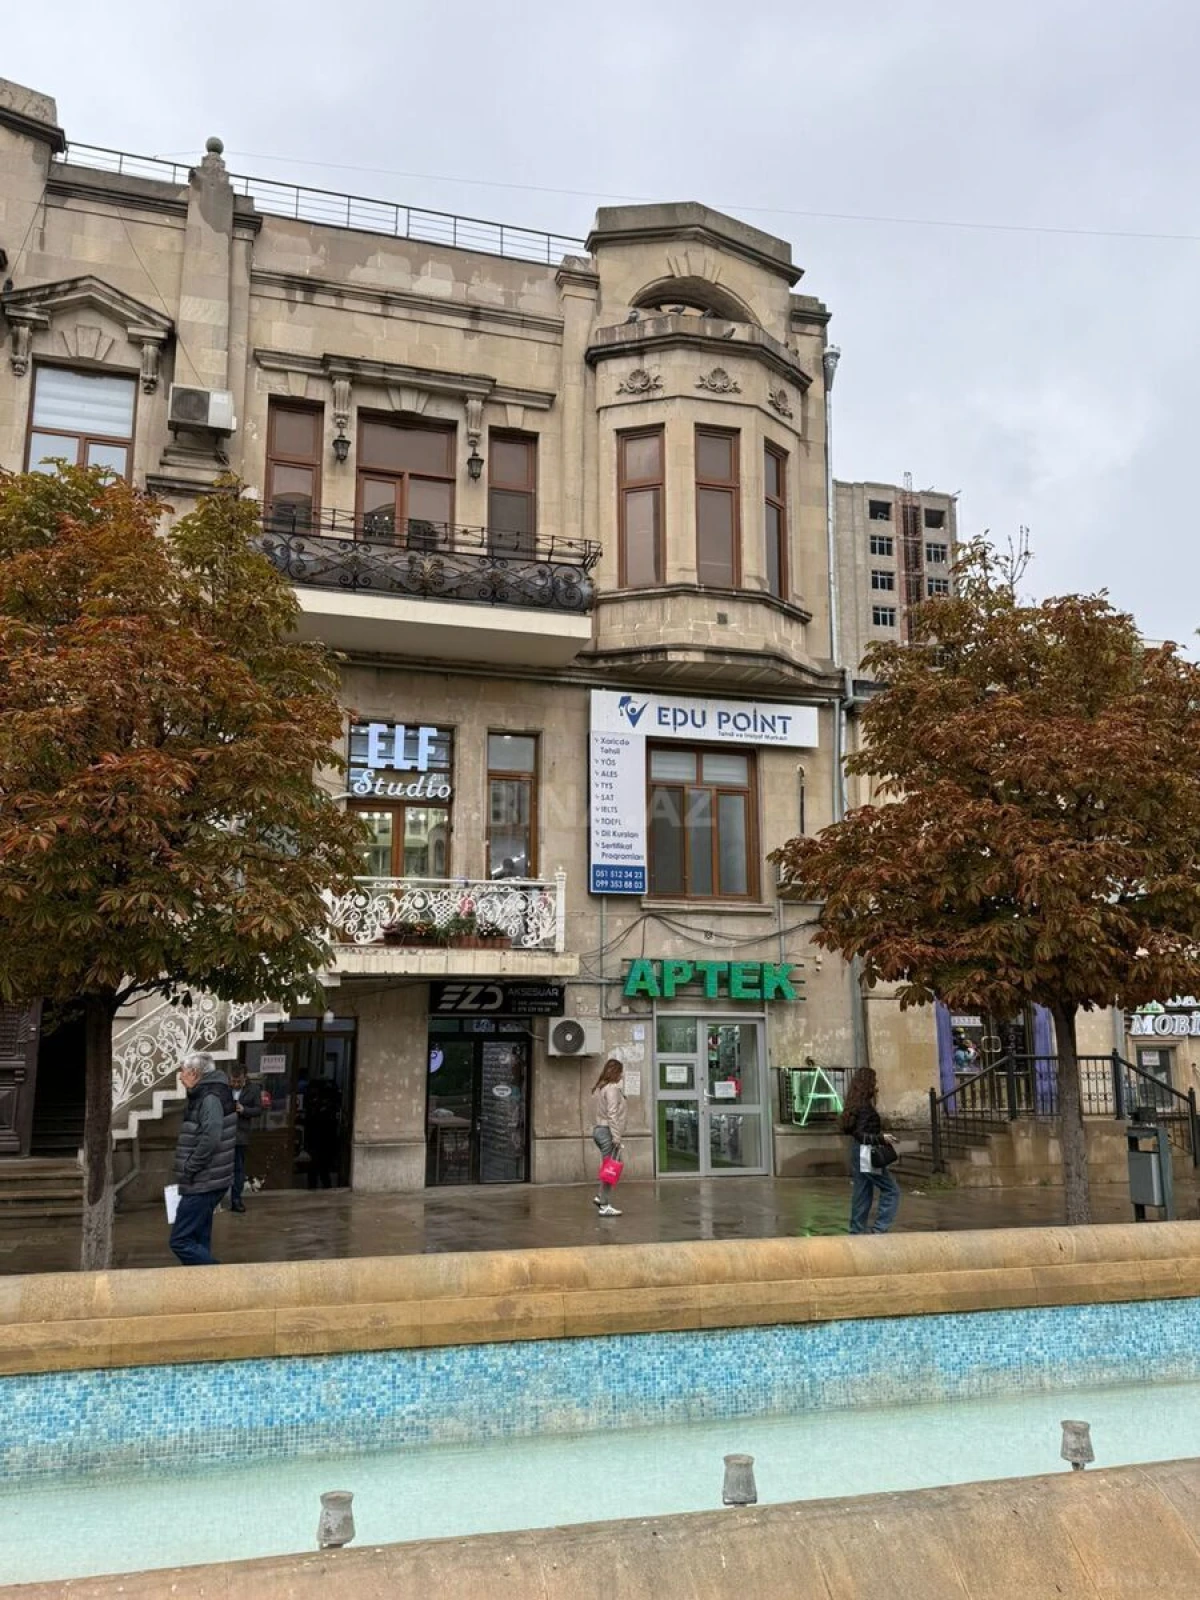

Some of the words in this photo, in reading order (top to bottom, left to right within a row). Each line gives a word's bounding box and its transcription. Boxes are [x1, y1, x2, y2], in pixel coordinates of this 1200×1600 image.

[657, 706, 706, 734] EDU
[367, 723, 438, 771] ELF
[353, 769, 452, 798] Studio
[600, 770, 618, 778] ALES
[623, 958, 798, 1000] APTEK
